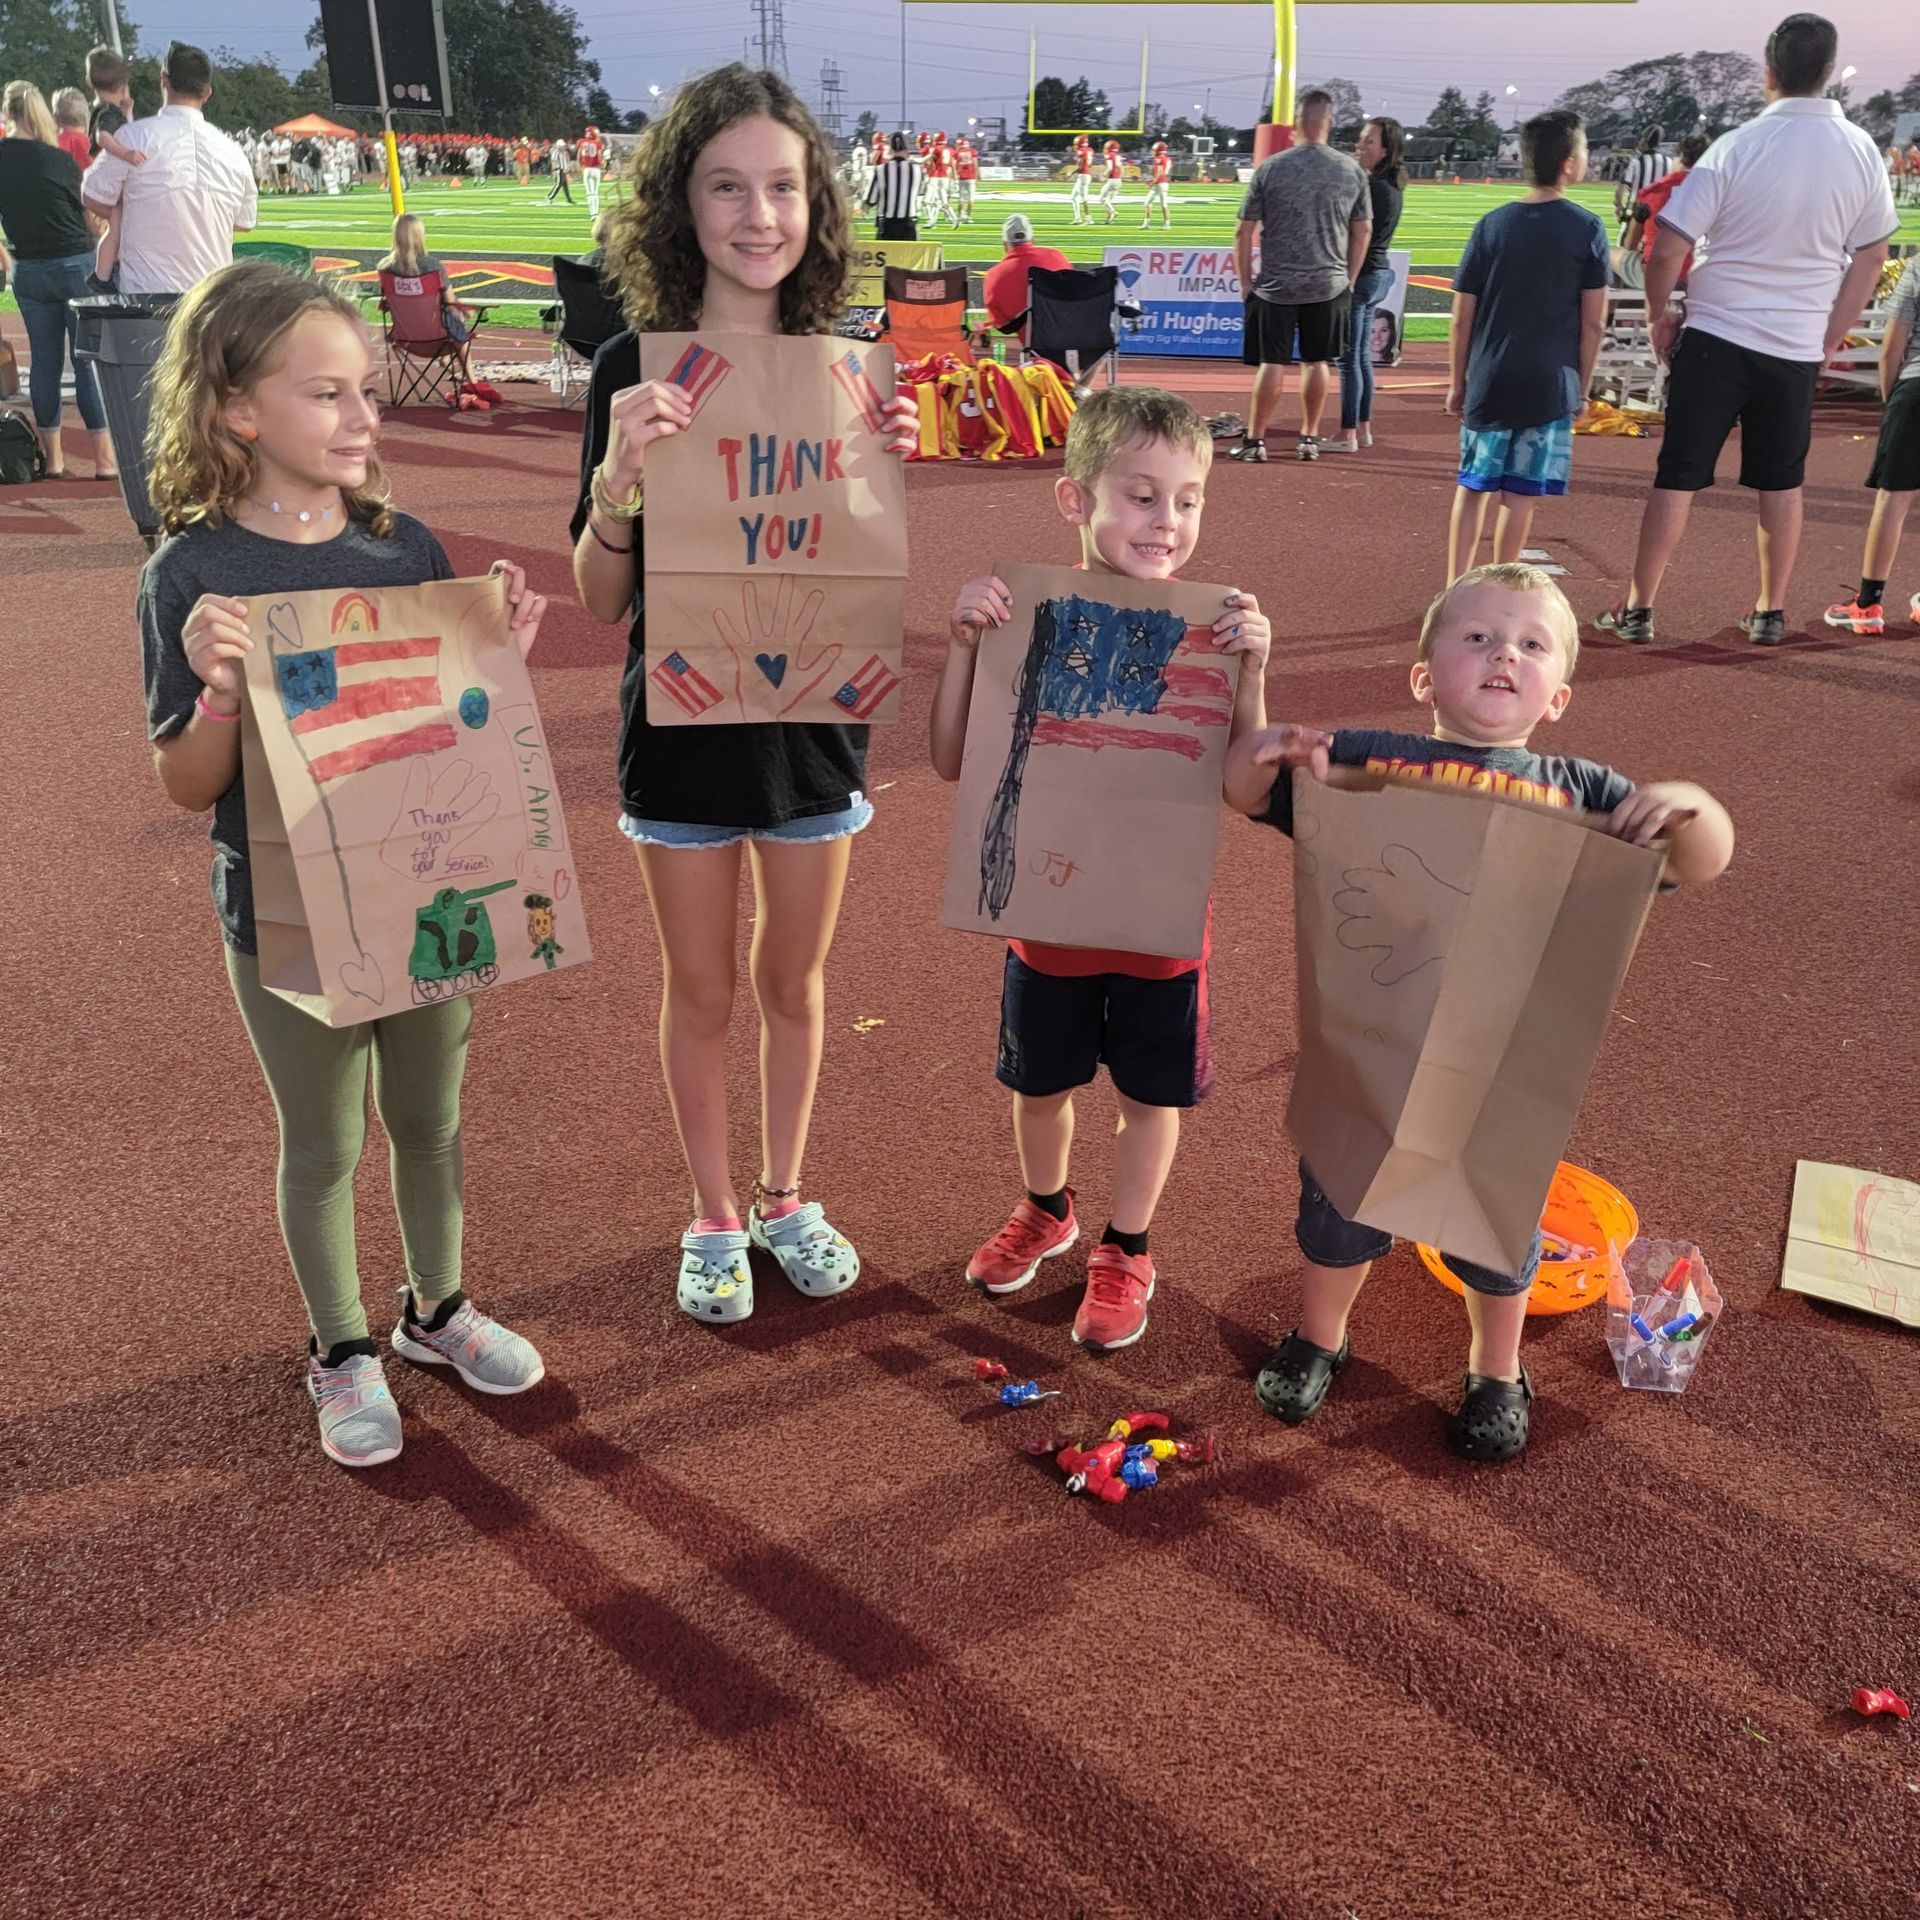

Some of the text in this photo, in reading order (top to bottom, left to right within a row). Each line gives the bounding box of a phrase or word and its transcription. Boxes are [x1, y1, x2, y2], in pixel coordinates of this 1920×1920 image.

[1178, 278, 1240, 292] IMPAC
[1163, 312, 1244, 334] Hughes
[718, 433, 846, 501] THANK
[738, 513, 823, 565] YOU!
[422, 830, 451, 850] you
[411, 846, 439, 862] for
[1028, 849, 1086, 887] JJ
